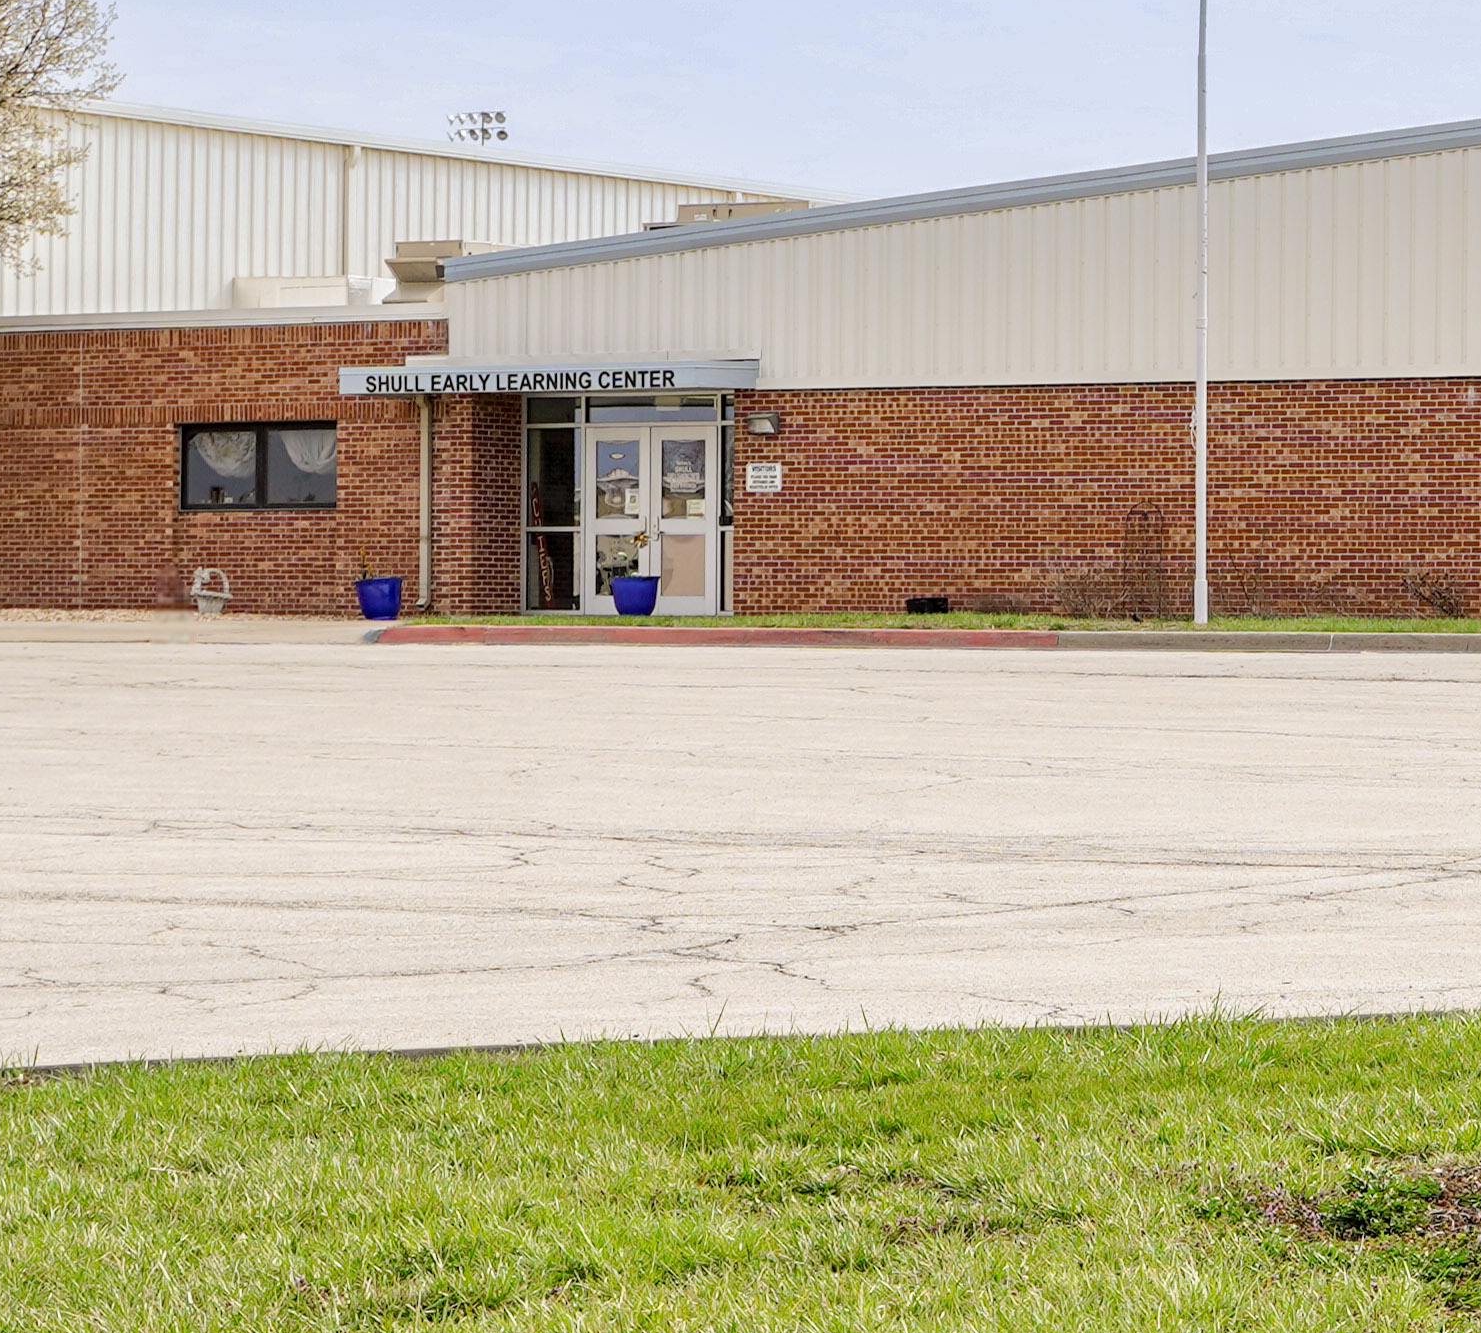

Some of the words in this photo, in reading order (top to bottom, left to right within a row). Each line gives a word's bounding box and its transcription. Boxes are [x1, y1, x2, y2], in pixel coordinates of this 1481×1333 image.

[365, 375, 424, 393] SHULL
[430, 374, 491, 392] EARLY
[496, 370, 592, 391] LEARNING
[598, 369, 676, 389] CENTER
